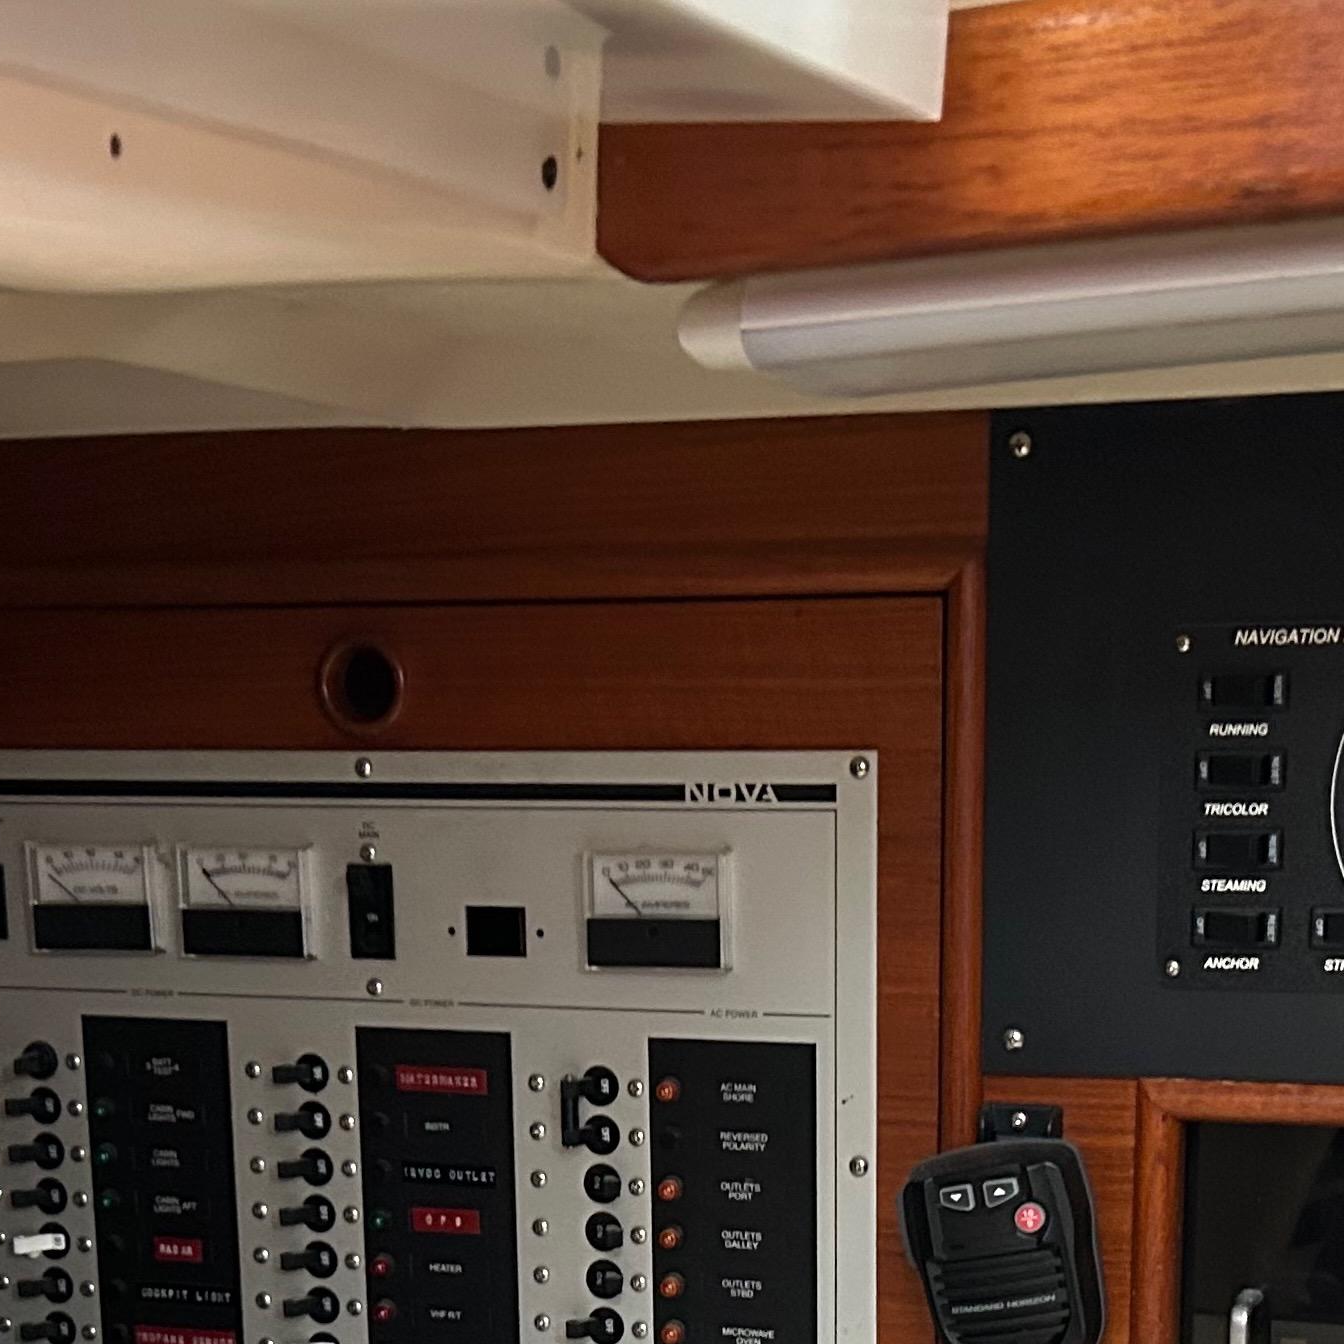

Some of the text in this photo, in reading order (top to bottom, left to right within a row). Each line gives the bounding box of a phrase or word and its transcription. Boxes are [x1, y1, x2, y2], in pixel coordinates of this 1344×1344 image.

[1234, 627, 1340, 645] NAVIGATION
[1209, 723, 1269, 737] RUNNING
[684, 783, 779, 802] NOVA
[1204, 802, 1268, 817] TRICOLOR
[1201, 879, 1267, 892] STEAMING
[1203, 957, 1259, 971] ANCHOR
[721, 1083, 756, 1094] AC MAIN
[720, 1131, 768, 1143] REVERSED
[722, 1141, 765, 1152] POLARITY
[449, 1169, 495, 1184] OUTLET
[720, 1181, 761, 1193] OUTLETS
[728, 1192, 752, 1201] PORT
[721, 1230, 762, 1242] OUTLETS
[429, 1263, 463, 1274] HEATER
[722, 1279, 762, 1291] OUTLETS
[141, 1287, 231, 1304] COCKPIT LIGHT
[722, 1327, 775, 1340] MICROWAVE
